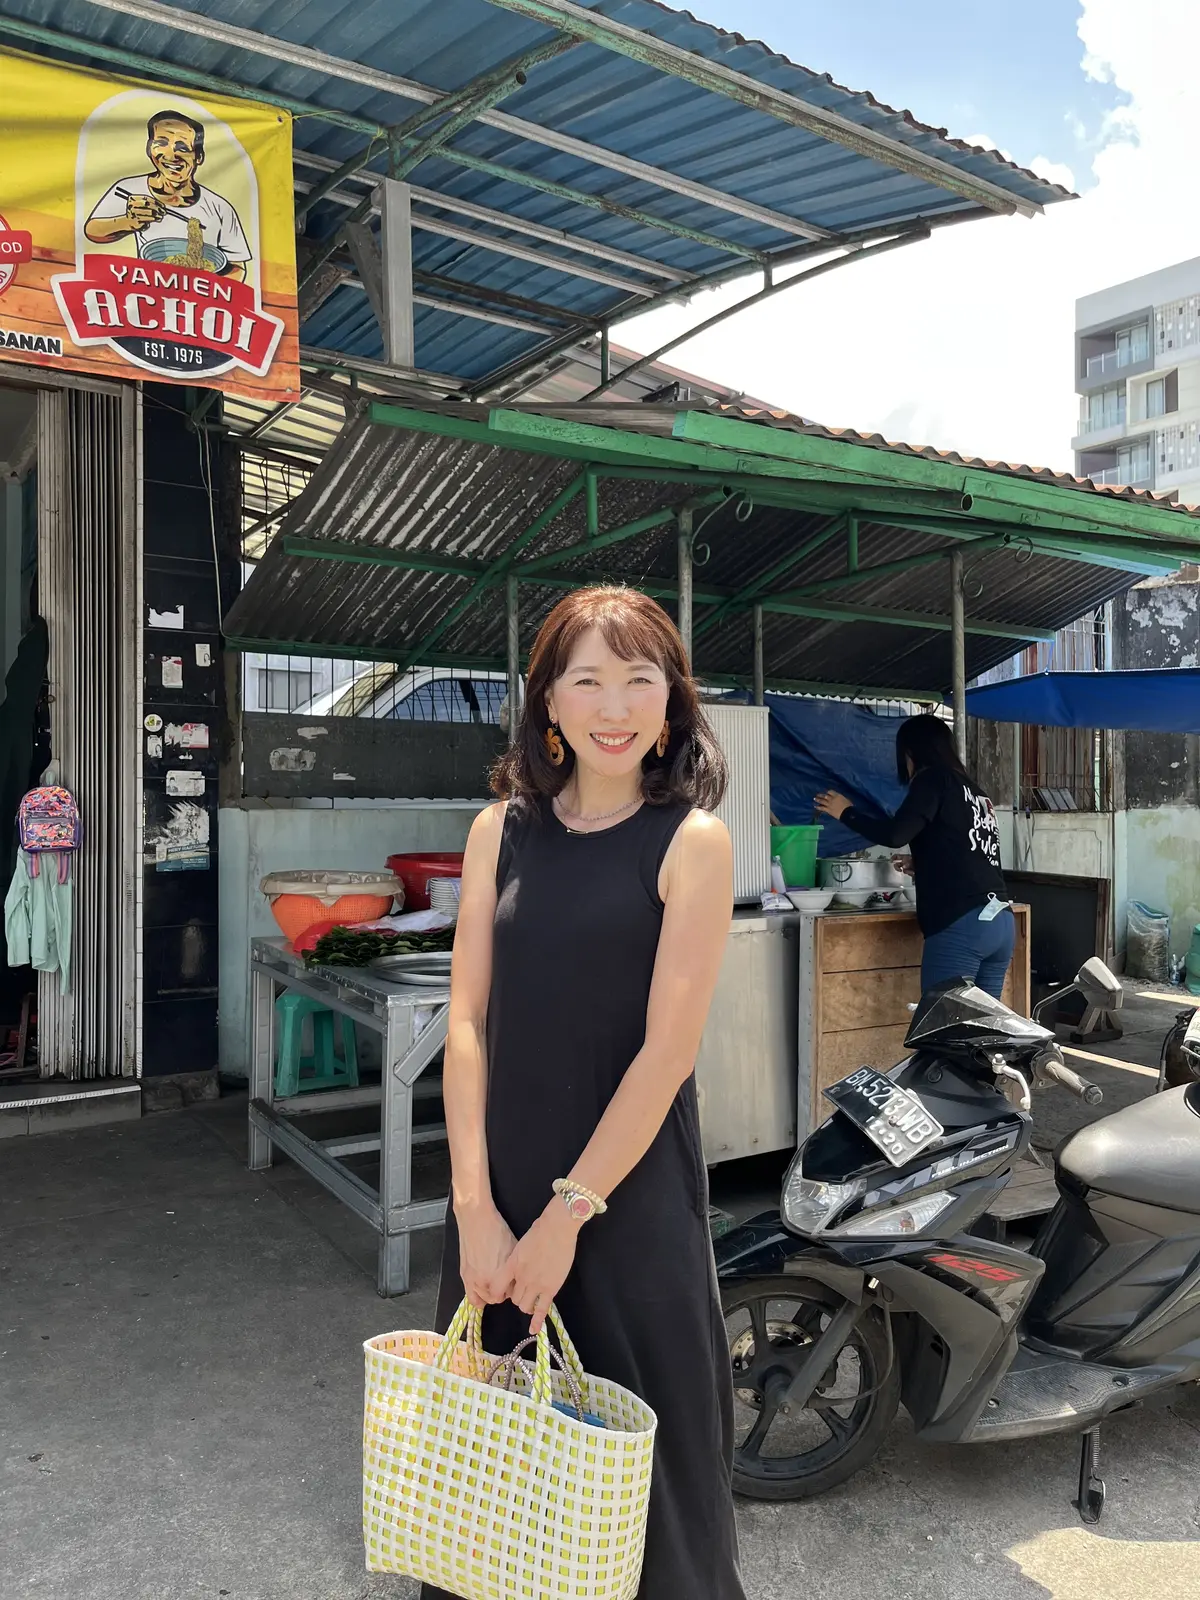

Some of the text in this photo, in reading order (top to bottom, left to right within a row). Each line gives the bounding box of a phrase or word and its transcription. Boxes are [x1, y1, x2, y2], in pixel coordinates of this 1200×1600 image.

[110, 264, 232, 302] YAMIEN
[83, 288, 256, 353] ACHOI
[144, 341, 203, 364] EST. 1975
[862, 1078, 909, 1116] 5213
[896, 1106, 933, 1144] WB
[959, 1144, 1009, 1167] INJECTION
[928, 1253, 1023, 1281] 125
